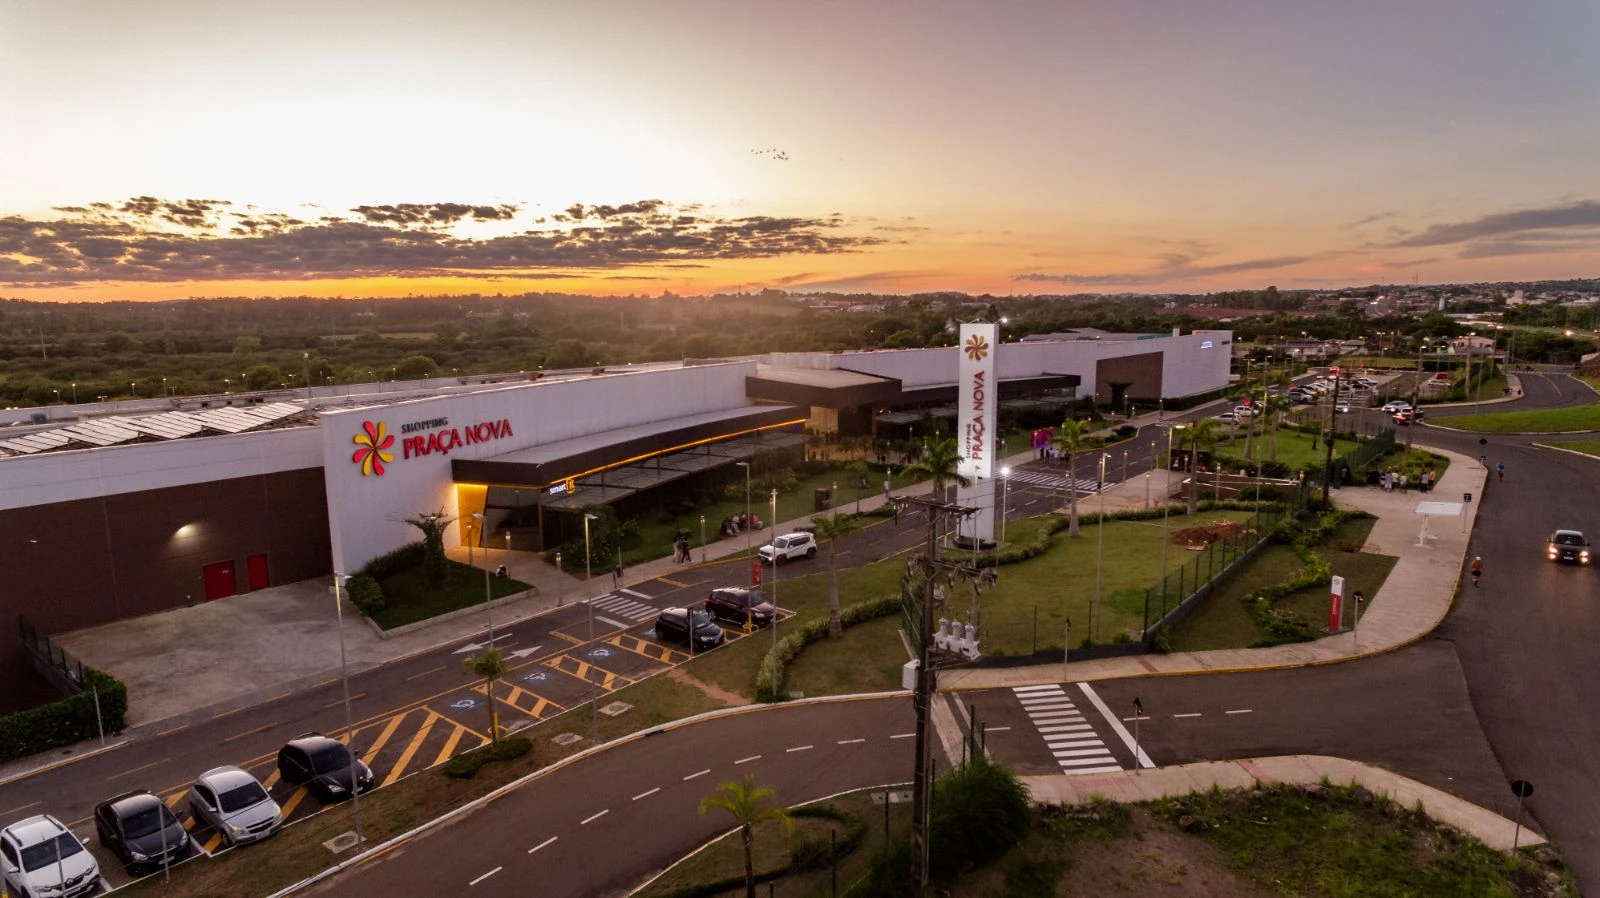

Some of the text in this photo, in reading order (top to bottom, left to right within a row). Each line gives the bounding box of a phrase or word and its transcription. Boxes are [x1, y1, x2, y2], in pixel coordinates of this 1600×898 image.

[401, 417, 448, 433] SHOPPING
[972, 371, 985, 460] PRAÇA NOVA
[403, 419, 513, 459] PRAÇA NOVA
